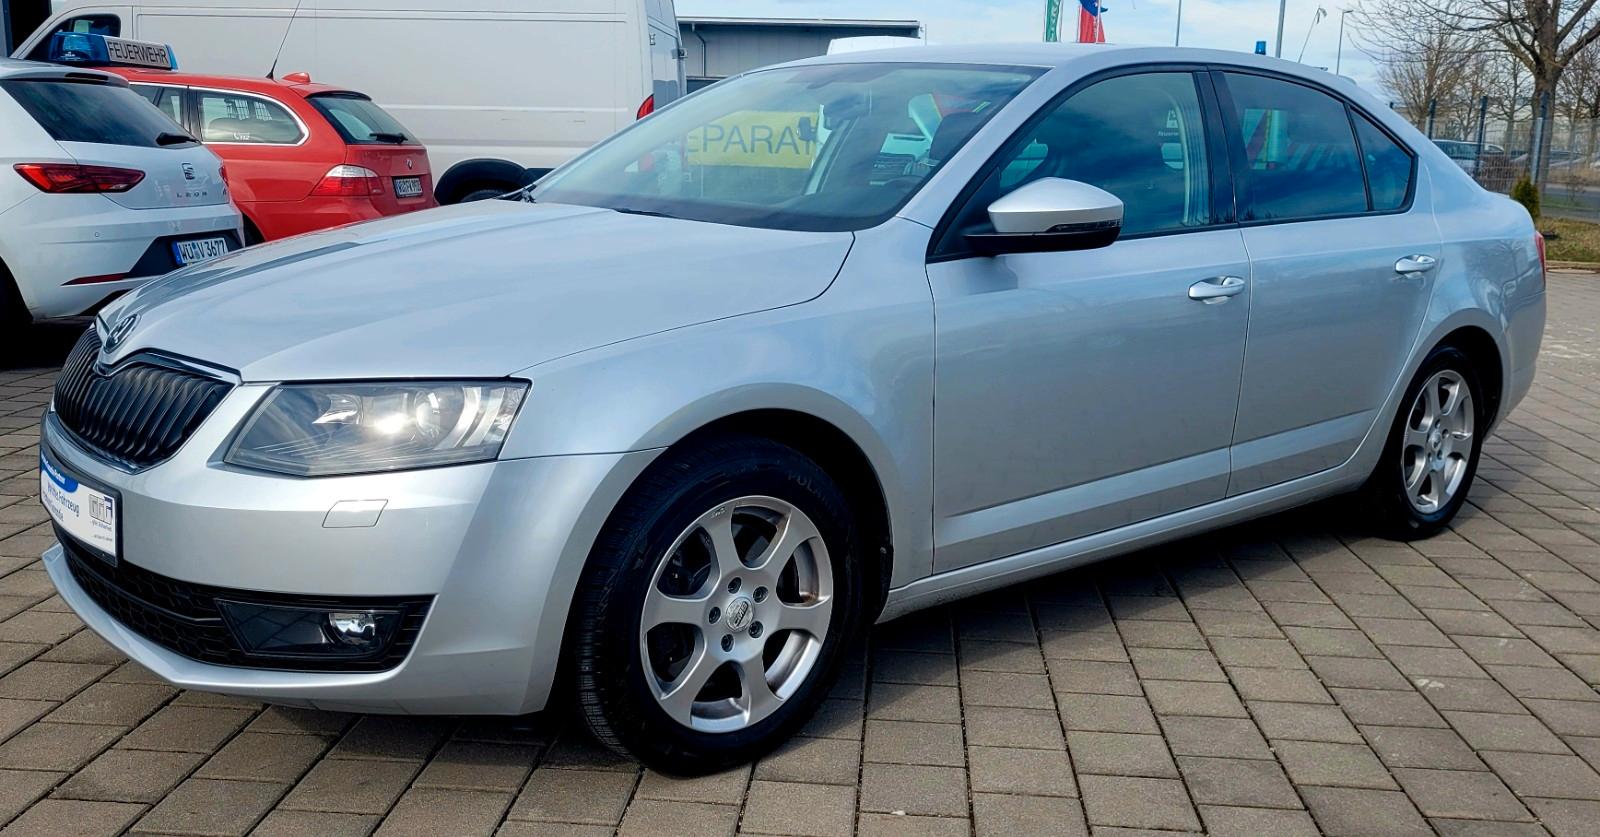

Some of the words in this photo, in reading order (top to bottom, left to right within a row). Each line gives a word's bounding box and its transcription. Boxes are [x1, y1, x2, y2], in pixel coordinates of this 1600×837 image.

[107, 41, 169, 64] FEUERWEHR
[178, 241, 194, 263] WÜ
[197, 242, 205, 259] V
[205, 239, 226, 258] 3677
